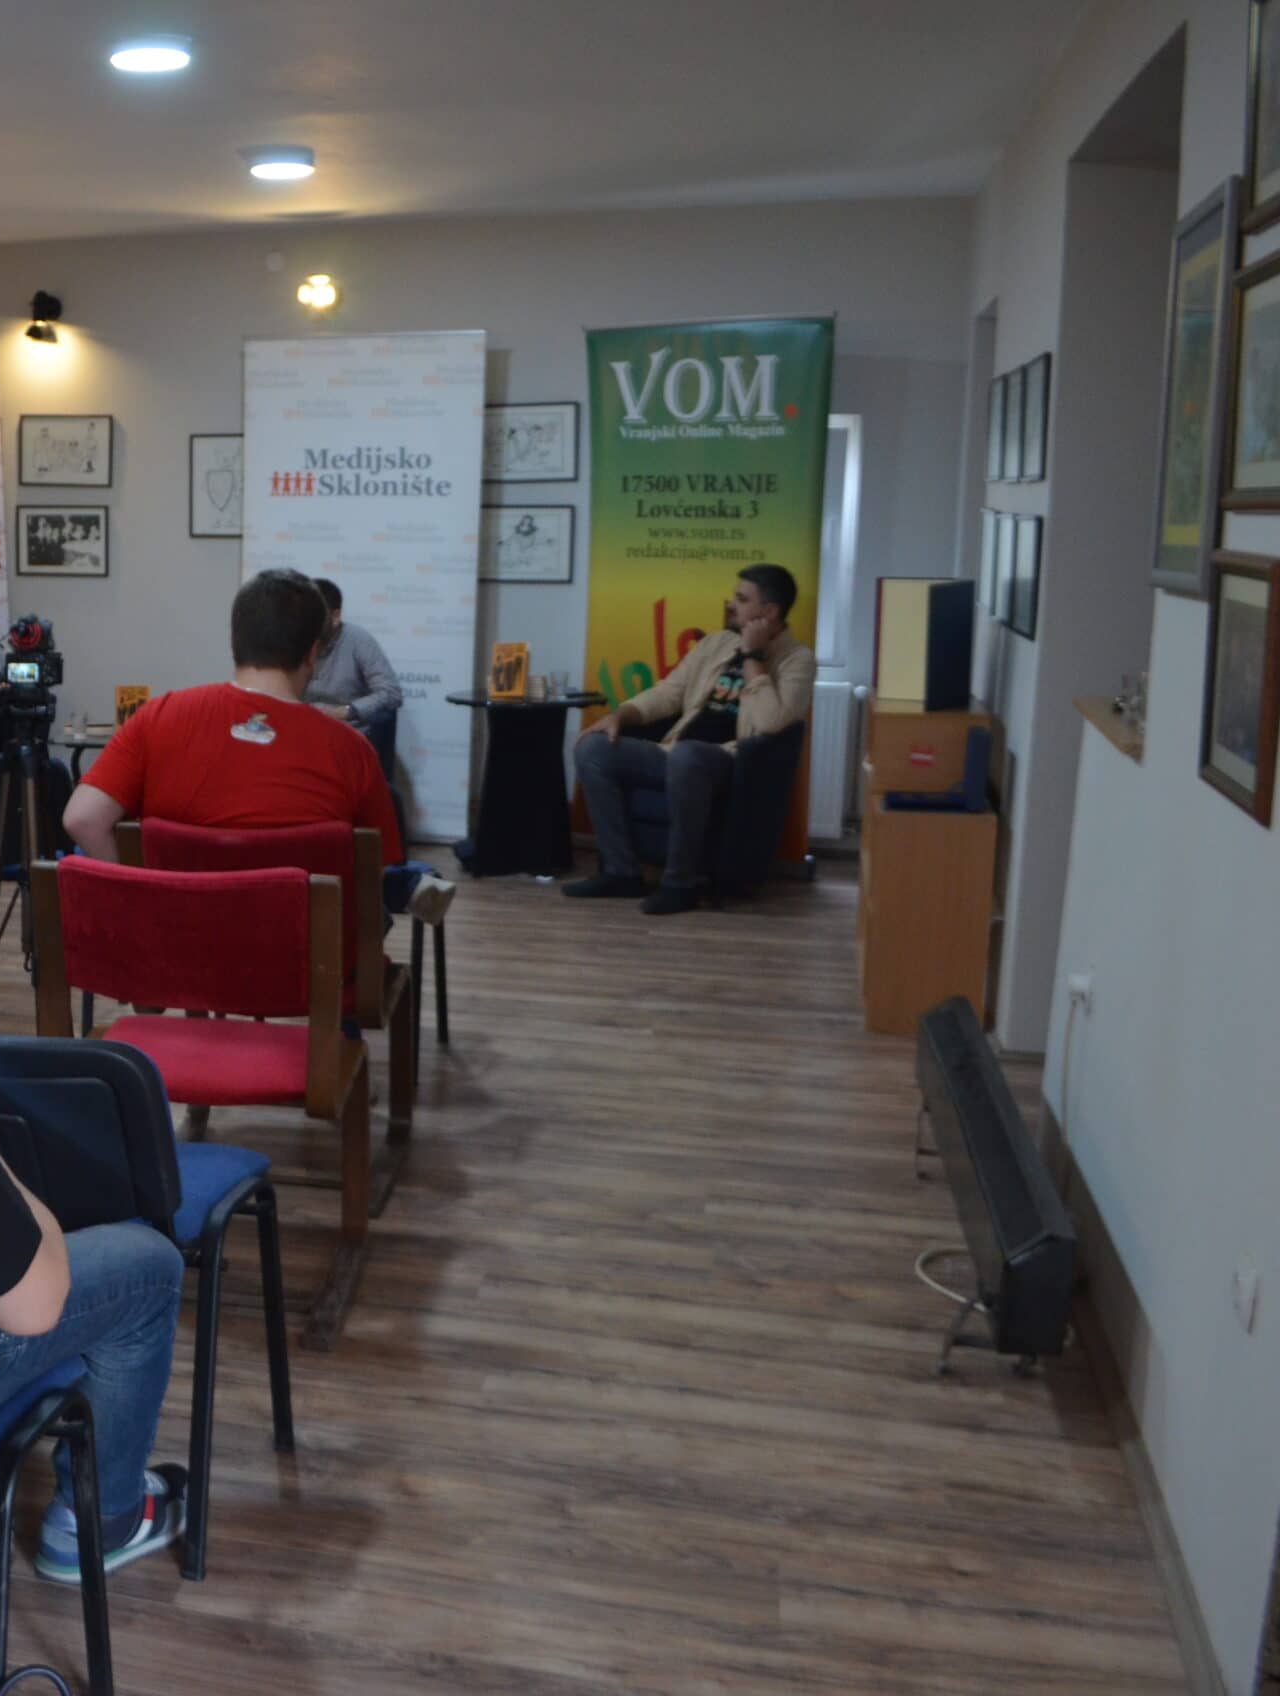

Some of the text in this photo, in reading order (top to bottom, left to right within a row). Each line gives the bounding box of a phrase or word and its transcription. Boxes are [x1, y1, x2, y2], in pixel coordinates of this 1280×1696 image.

[304, 446, 432, 475] Medijsko
[317, 472, 452, 497] Sklonište
[622, 473, 779, 495] 17500 VRANJE
[746, 500, 760, 520] 3
